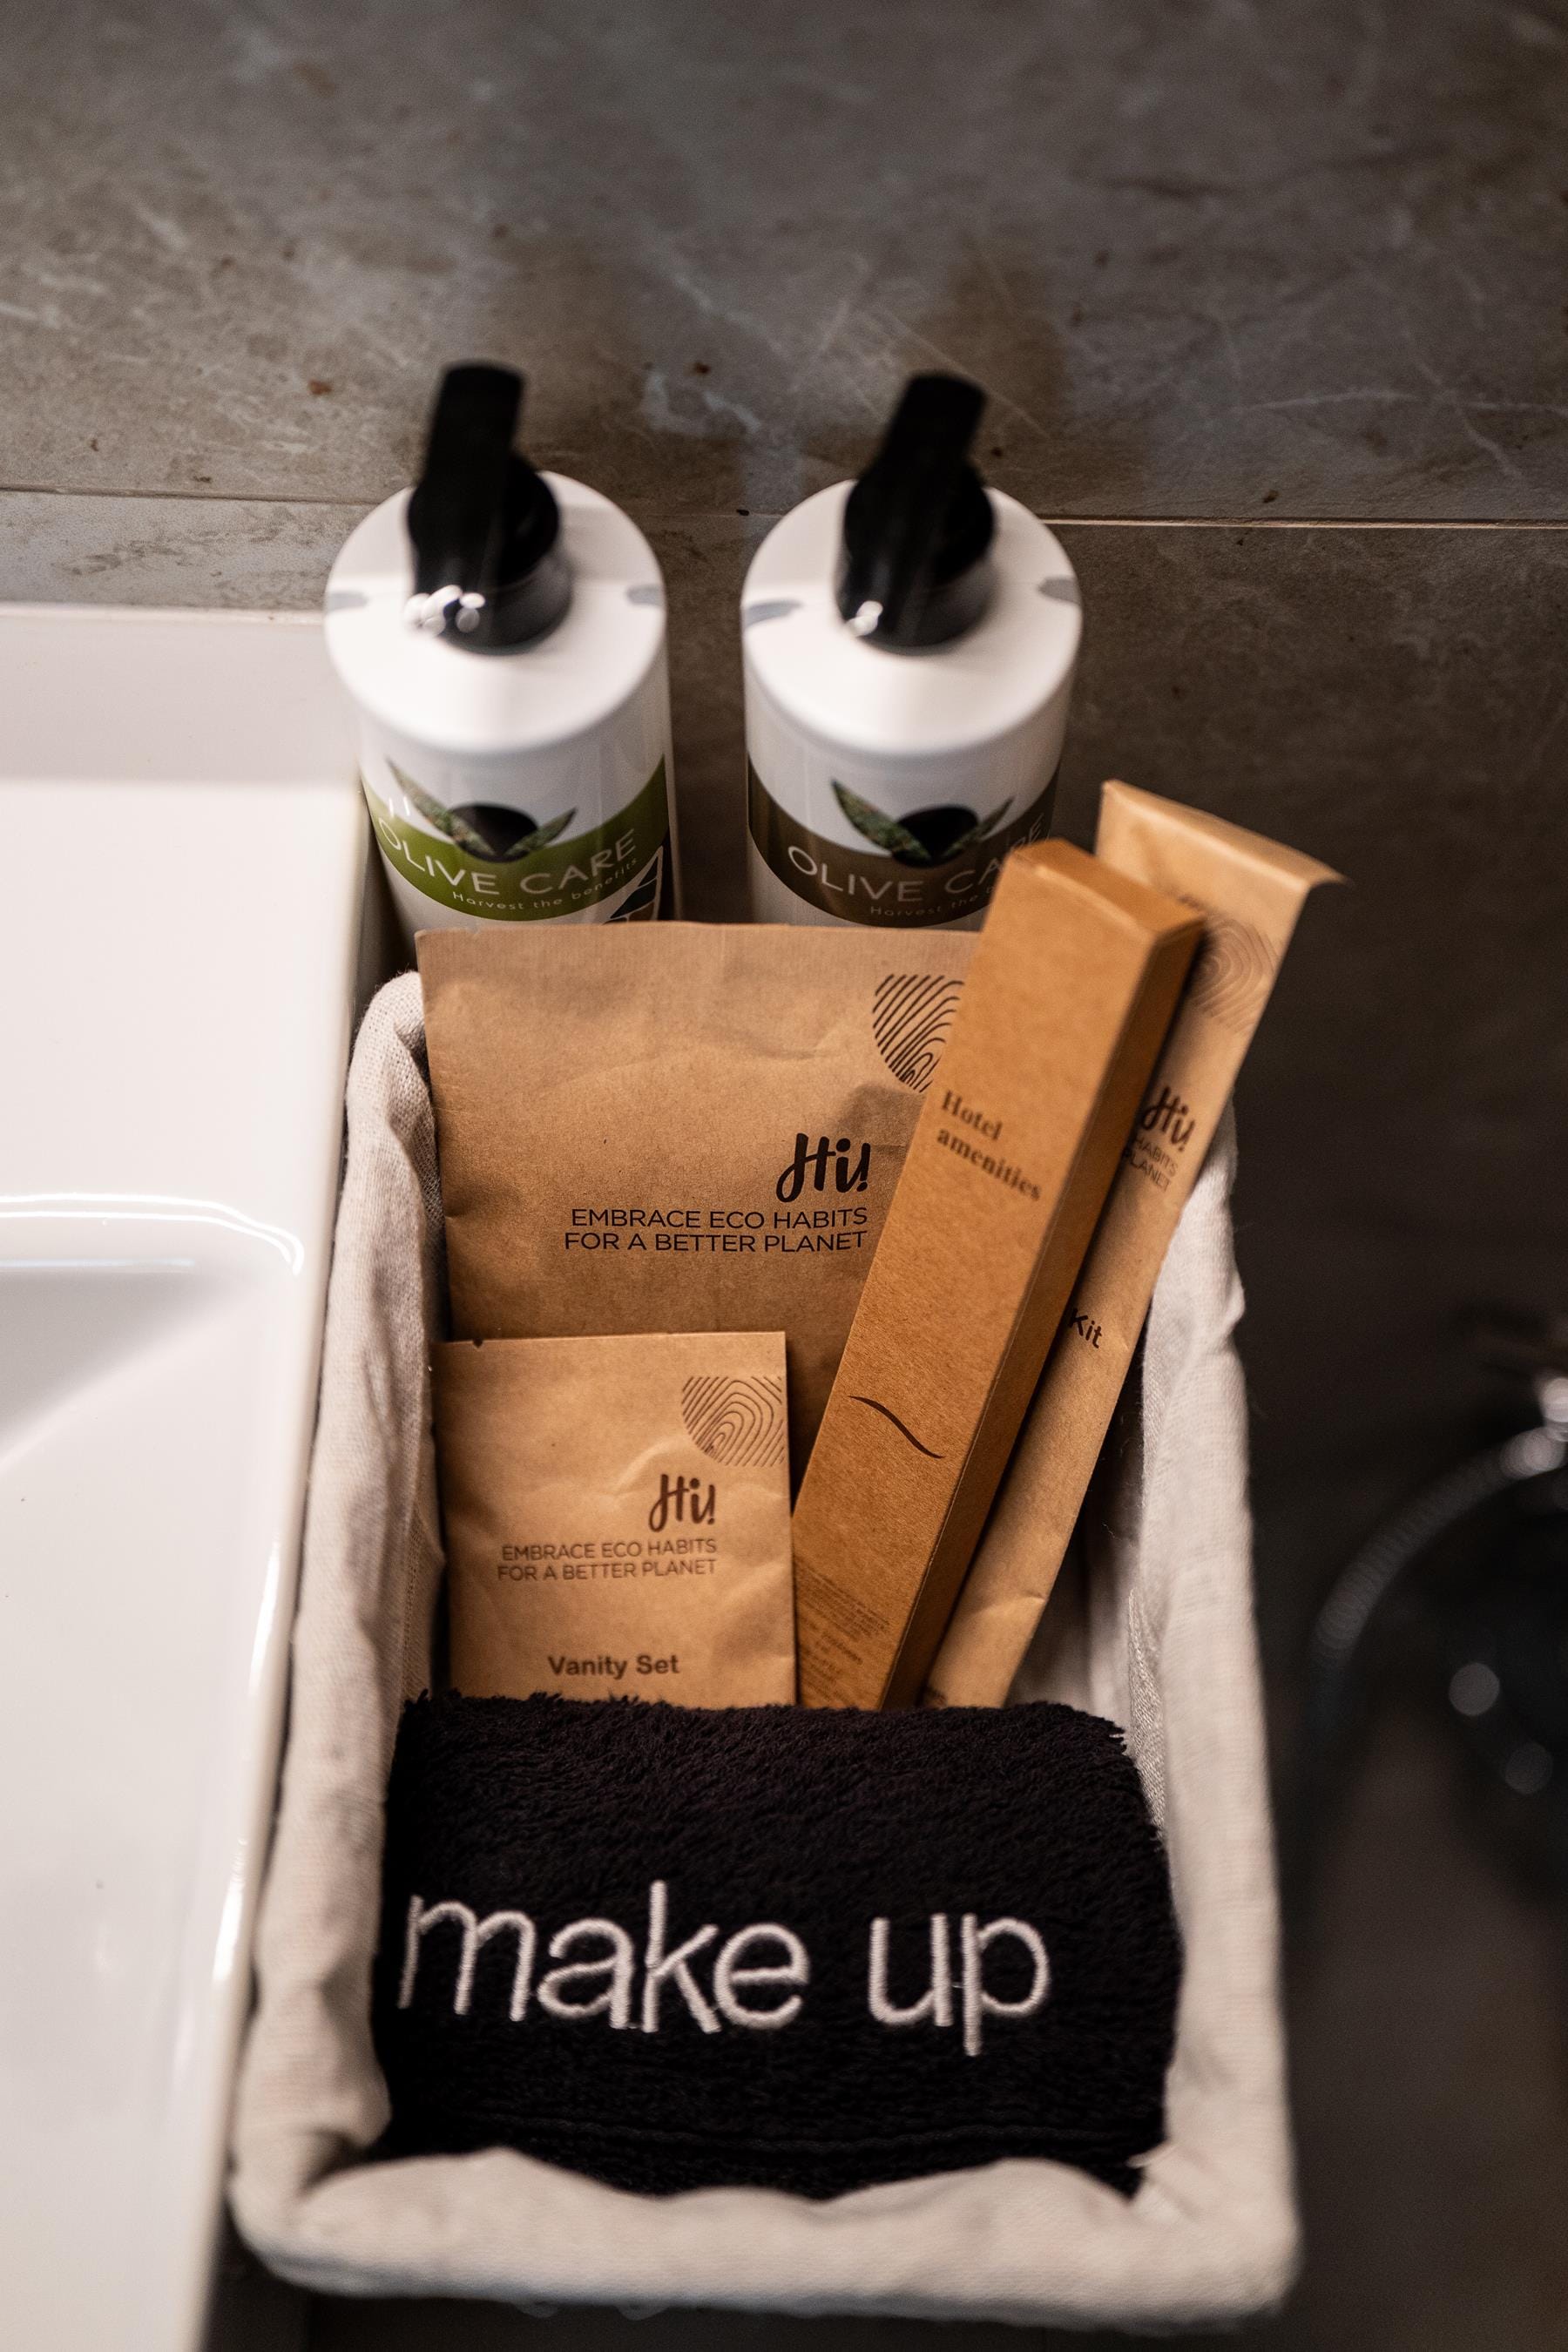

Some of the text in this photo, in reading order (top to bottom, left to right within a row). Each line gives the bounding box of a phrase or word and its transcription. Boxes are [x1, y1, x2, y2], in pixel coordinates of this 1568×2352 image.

[378, 817, 635, 896] OLIVE CARE
[787, 845, 924, 902] OLIVE
[452, 858, 637, 910] Harvest the benefits
[870, 895, 979, 916] Harvest the
[941, 1090, 1004, 1142] Hotel
[1142, 1086, 1195, 1152] Hi!
[775, 1132, 871, 1203] Hi!
[936, 1127, 1042, 1202] amenities
[564, 1231, 868, 1253] FOR A BETTER PLANET
[571, 1206, 868, 1229] EMBRACE ECO HABITS
[1068, 1308, 1103, 1348] Kit
[648, 1474, 715, 1532] Hi!
[497, 1559, 717, 1581] FOR A BETTER PLANET
[501, 1538, 717, 1561] EMBRACE ECO HABITS
[547, 1654, 680, 1680] Vanity Set
[396, 1880, 1051, 2058] make up
